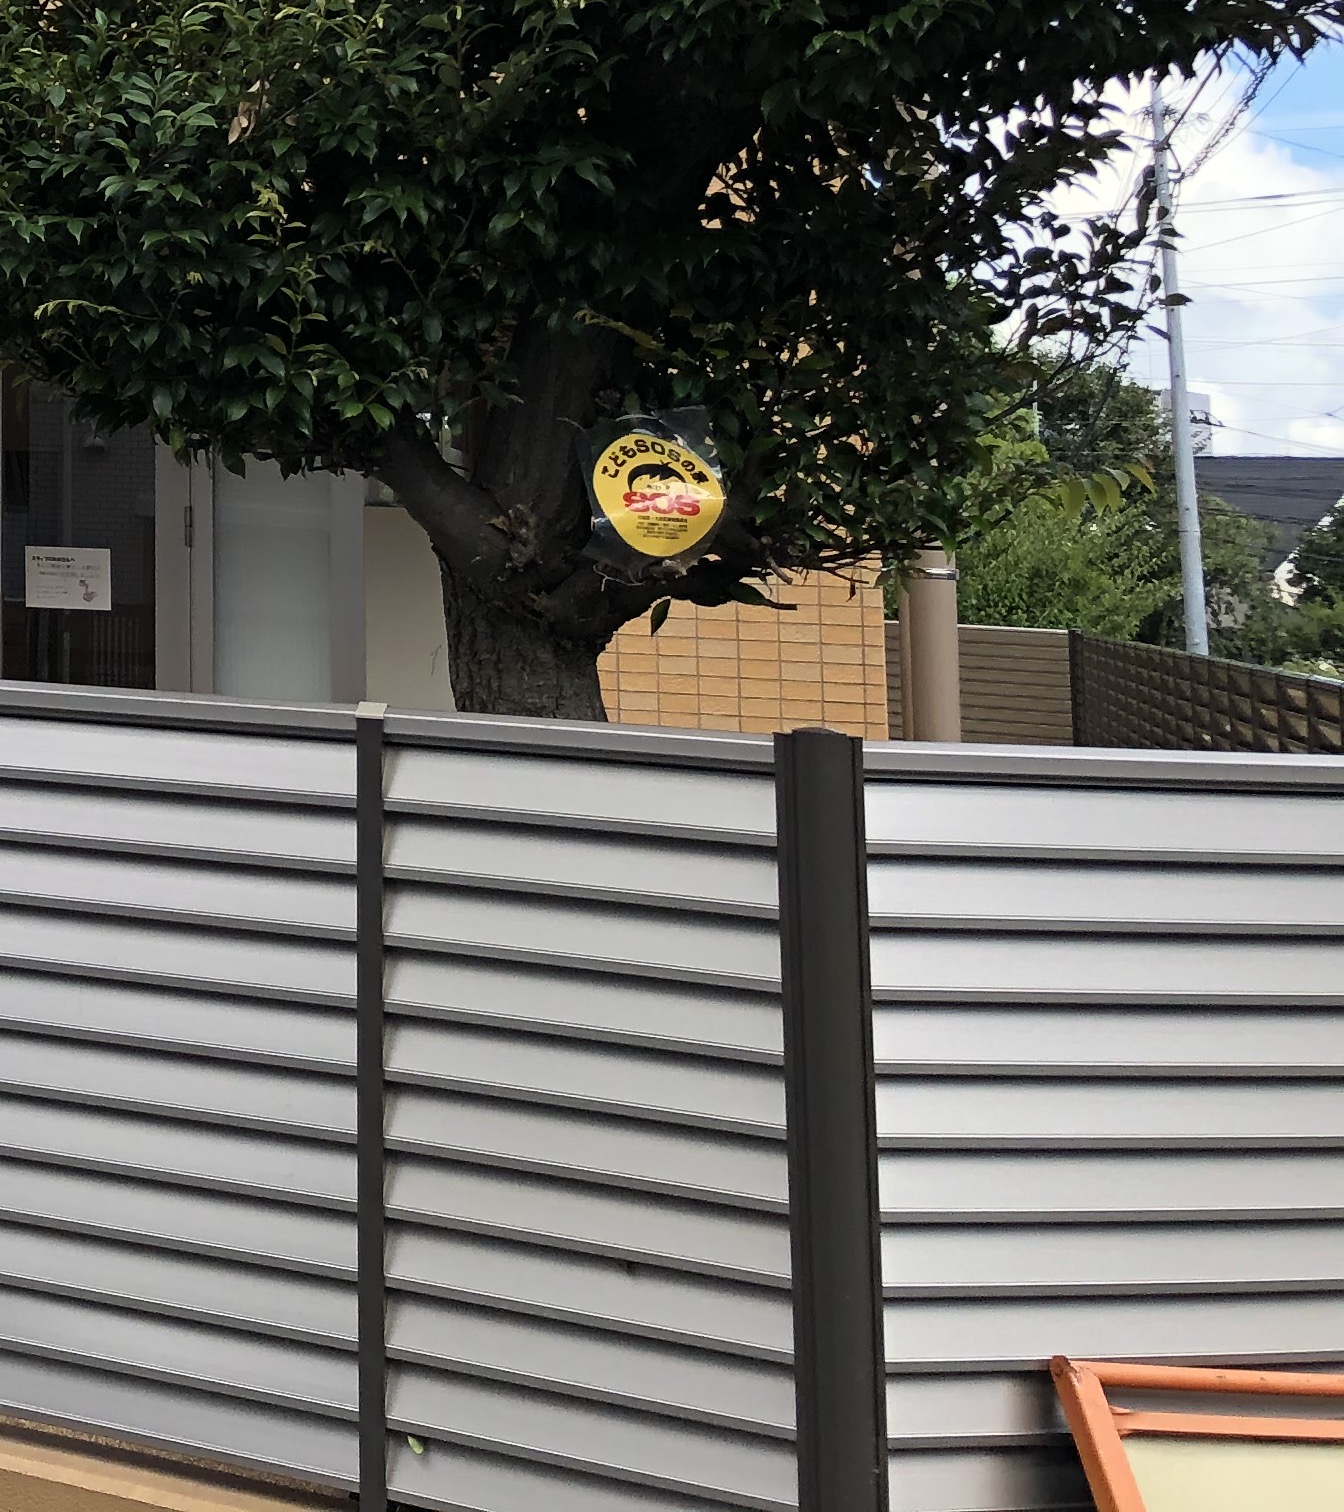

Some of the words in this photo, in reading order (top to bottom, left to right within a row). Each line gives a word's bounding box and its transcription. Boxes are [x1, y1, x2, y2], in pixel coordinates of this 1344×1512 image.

[601, 439, 710, 485] こどもSOSの家
[622, 491, 701, 517] SOS
